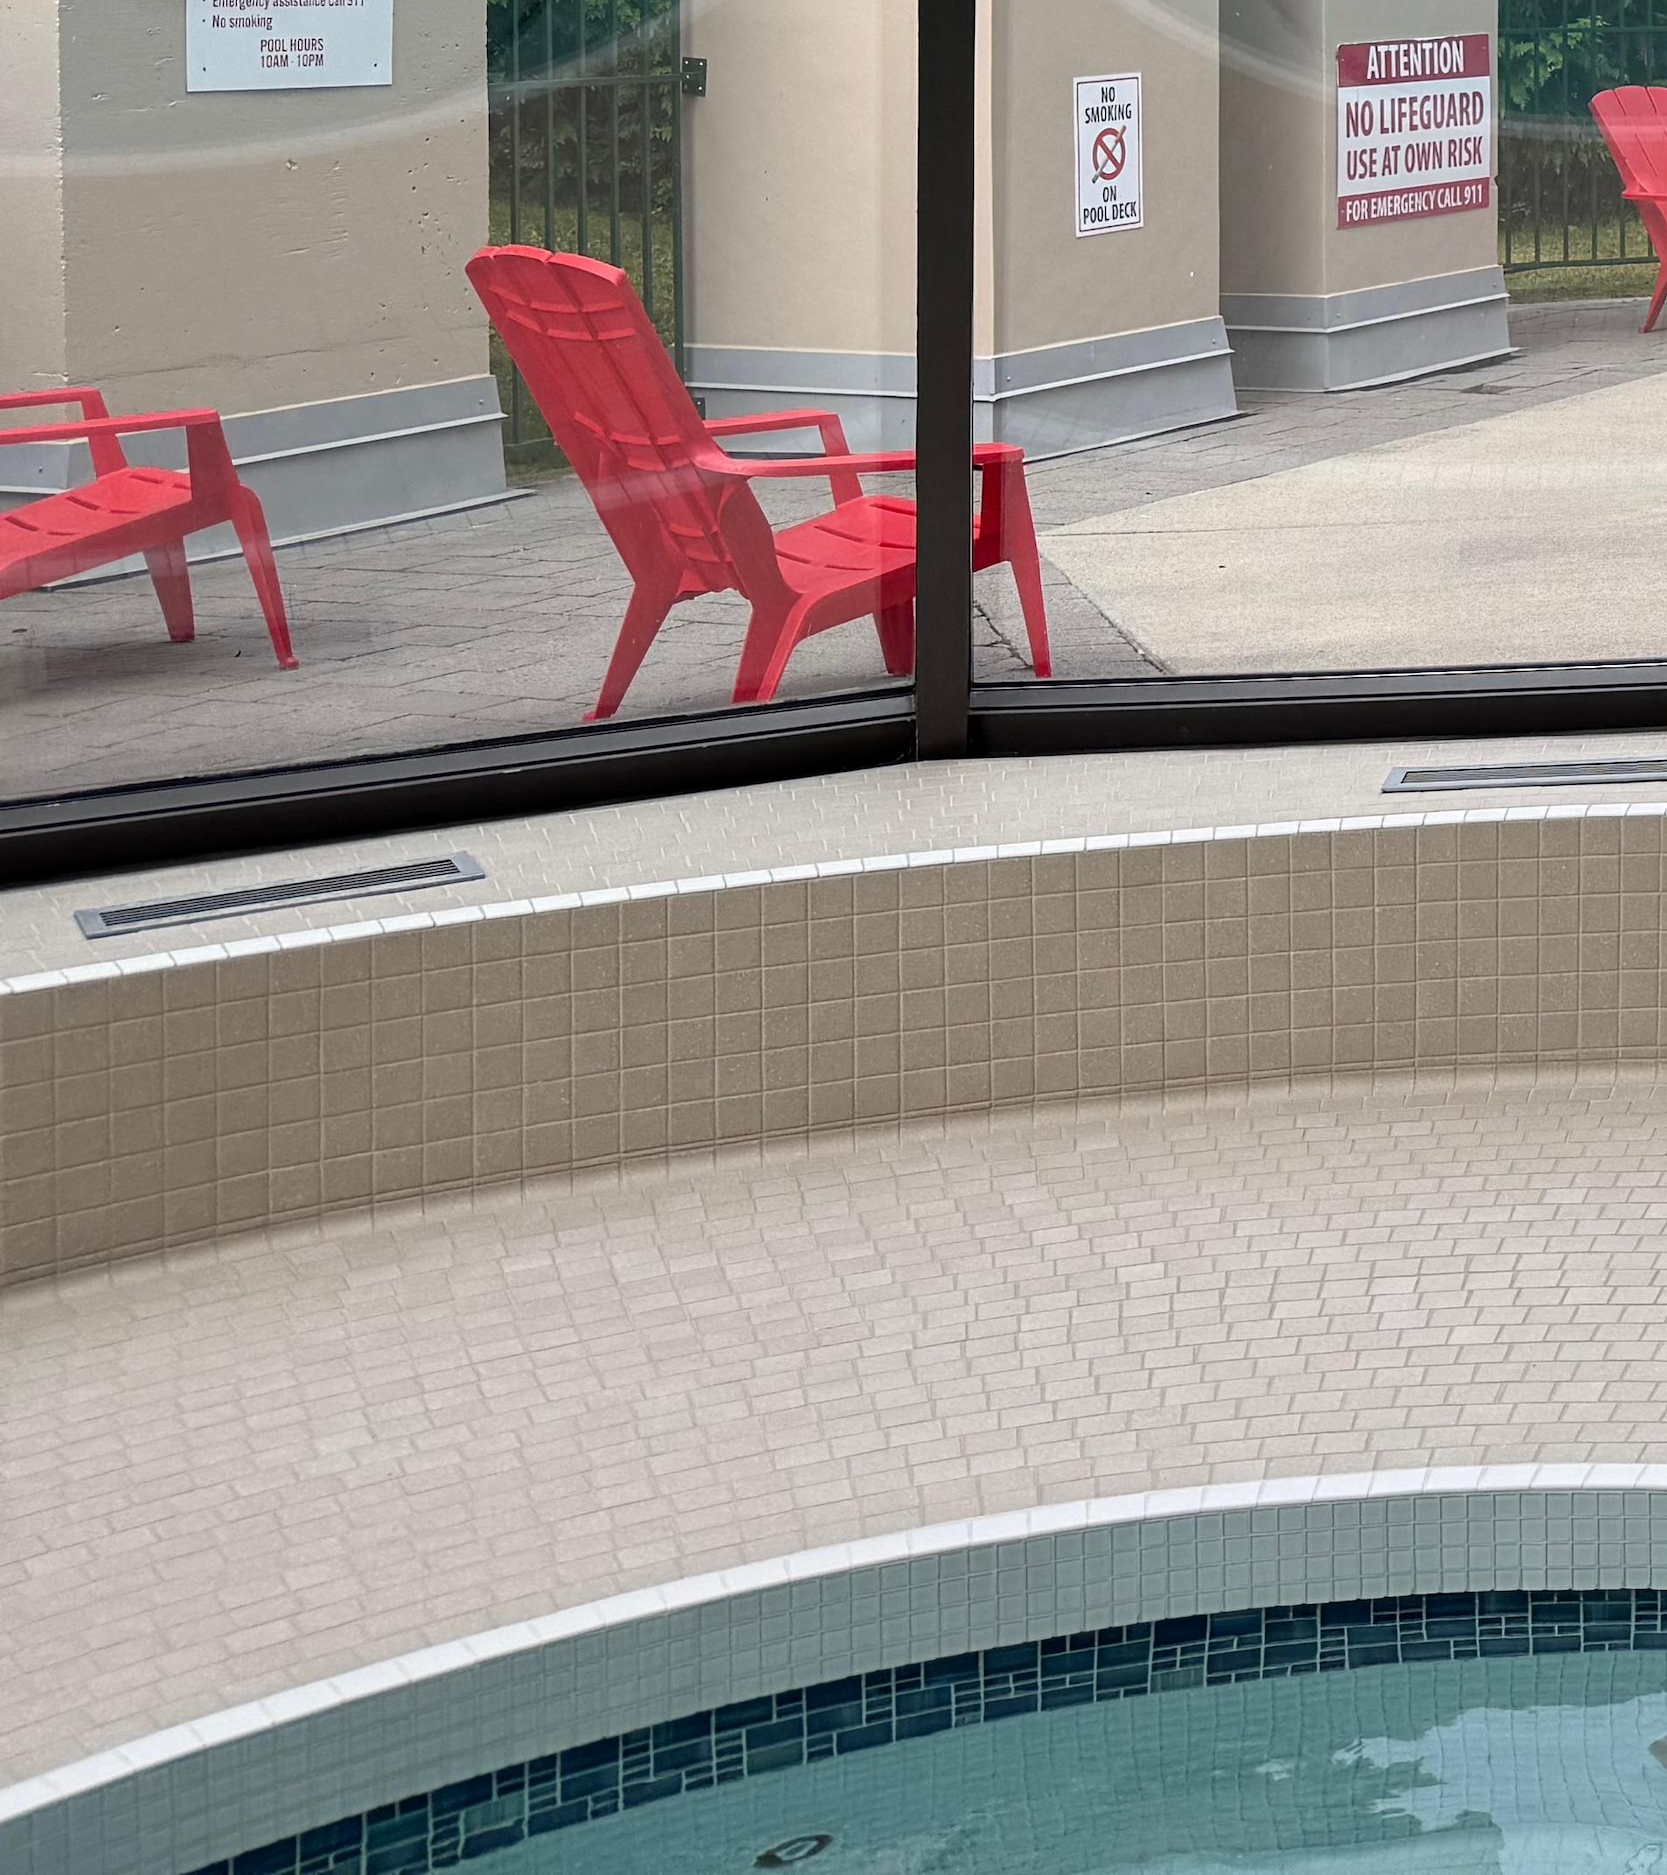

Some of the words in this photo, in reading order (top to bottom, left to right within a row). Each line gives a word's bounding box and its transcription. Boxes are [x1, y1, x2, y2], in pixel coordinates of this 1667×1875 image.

[212, 15, 226, 28] No
[229, 14, 273, 30] smoking
[260, 38, 287, 52] POOL
[290, 38, 324, 52] HOURS
[261, 54, 289, 68] 10AM
[297, 54, 324, 67] 10PM
[1367, 40, 1464, 79] ATTENTION
[1101, 86, 1115, 103] NO
[1085, 103, 1132, 124] SMOKING
[1346, 100, 1374, 138] NO
[1380, 91, 1484, 134] LIFEGUARD
[1347, 148, 1378, 180] USE
[1381, 145, 1401, 176] AT
[1404, 140, 1443, 173] OWN
[1448, 136, 1483, 168] RISK
[1102, 185, 1117, 202] ON
[1346, 199, 1369, 222] FOR
[1371, 190, 1436, 218] EMERGENCY
[1437, 186, 1463, 209] CALL
[1464, 184, 1483, 205] 911
[1083, 206, 1109, 224] POOL
[1112, 201, 1137, 220] DECK
